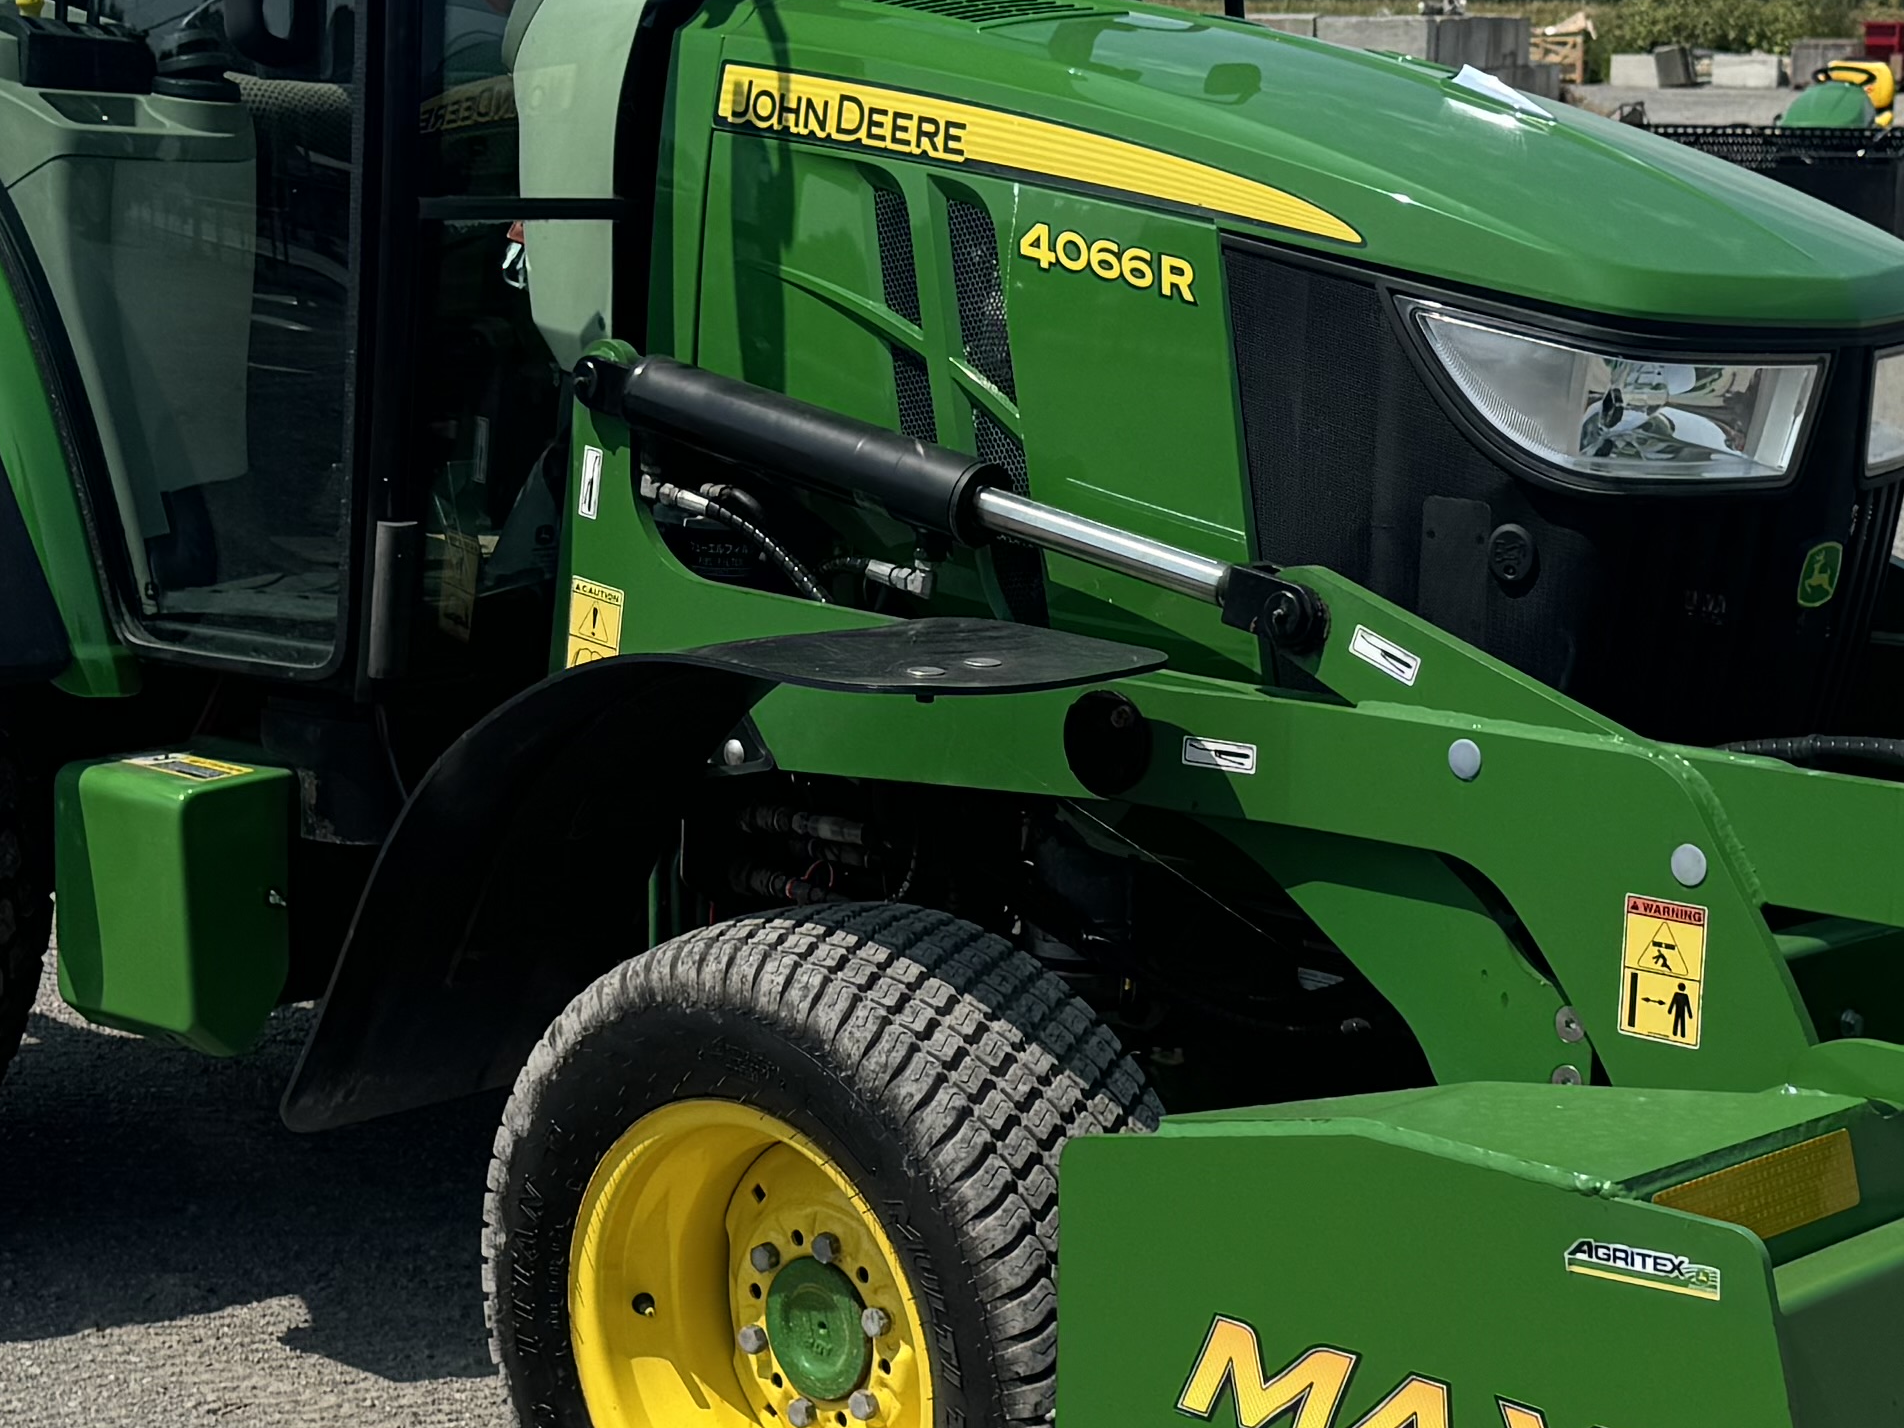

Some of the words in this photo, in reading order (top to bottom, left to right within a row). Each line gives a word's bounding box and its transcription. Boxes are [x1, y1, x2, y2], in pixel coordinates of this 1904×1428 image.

[732, 78, 829, 133] JOHN
[836, 93, 967, 156] DEERE
[582, 584, 620, 604] CAUTION
[1642, 902, 1703, 923] WARNING
[1566, 1239, 1692, 1278] AGRITEX
[879, 1199, 962, 1388] MULTI
